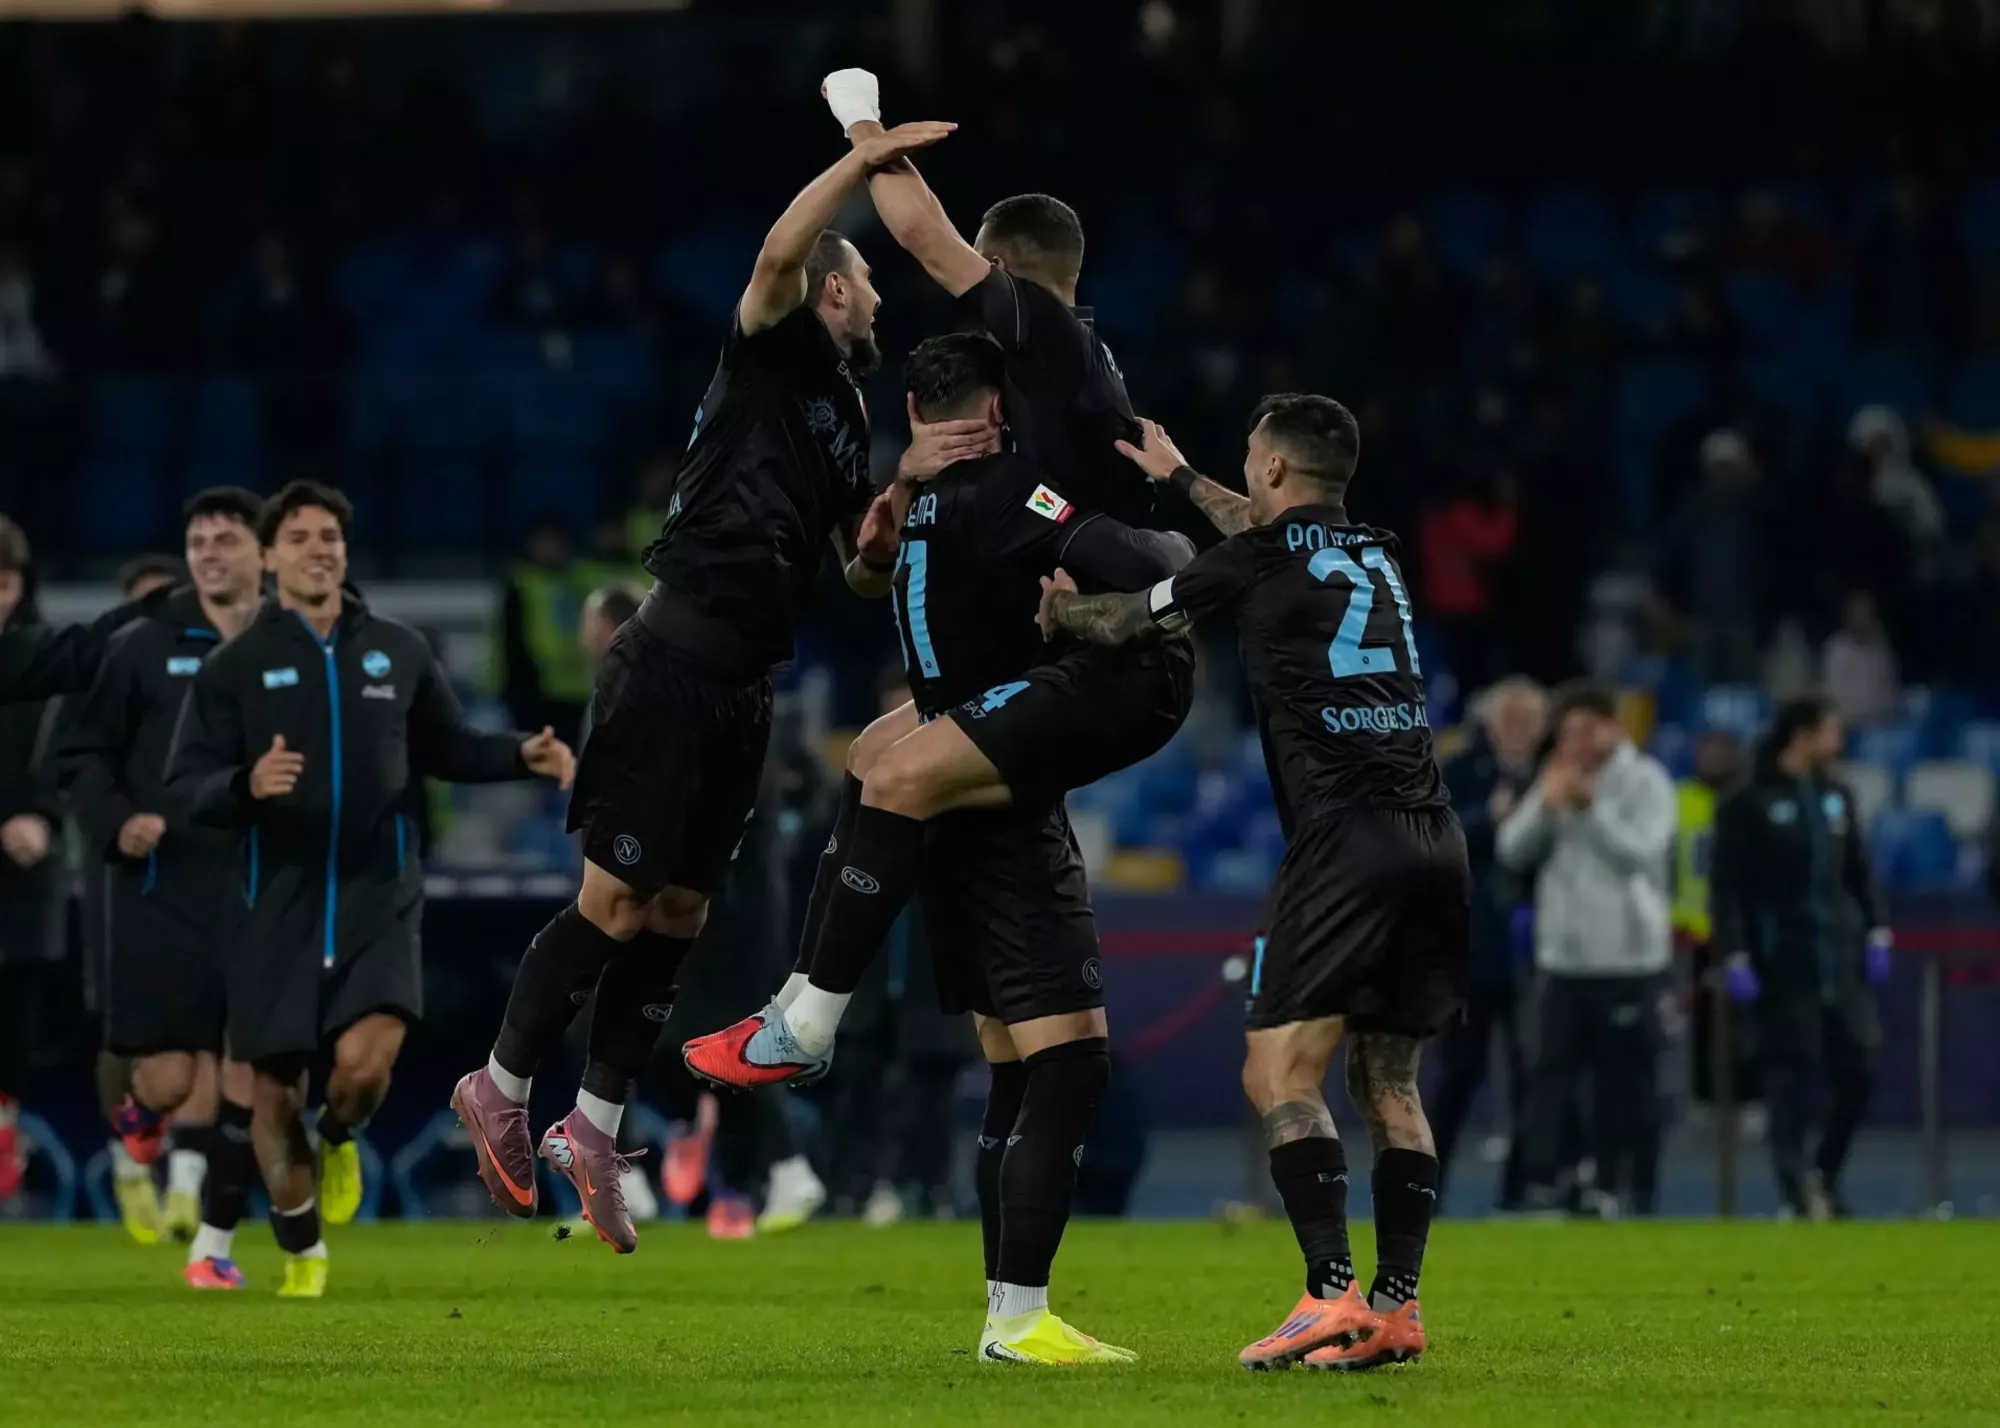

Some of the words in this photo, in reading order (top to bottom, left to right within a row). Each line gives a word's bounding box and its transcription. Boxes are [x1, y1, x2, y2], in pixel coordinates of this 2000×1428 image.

[892, 540, 941, 678] 1
[1307, 546, 1422, 679] 21
[962, 700, 987, 719] EA7
[981, 680, 1031, 712] 4
[1317, 1172, 1349, 1186] EA
